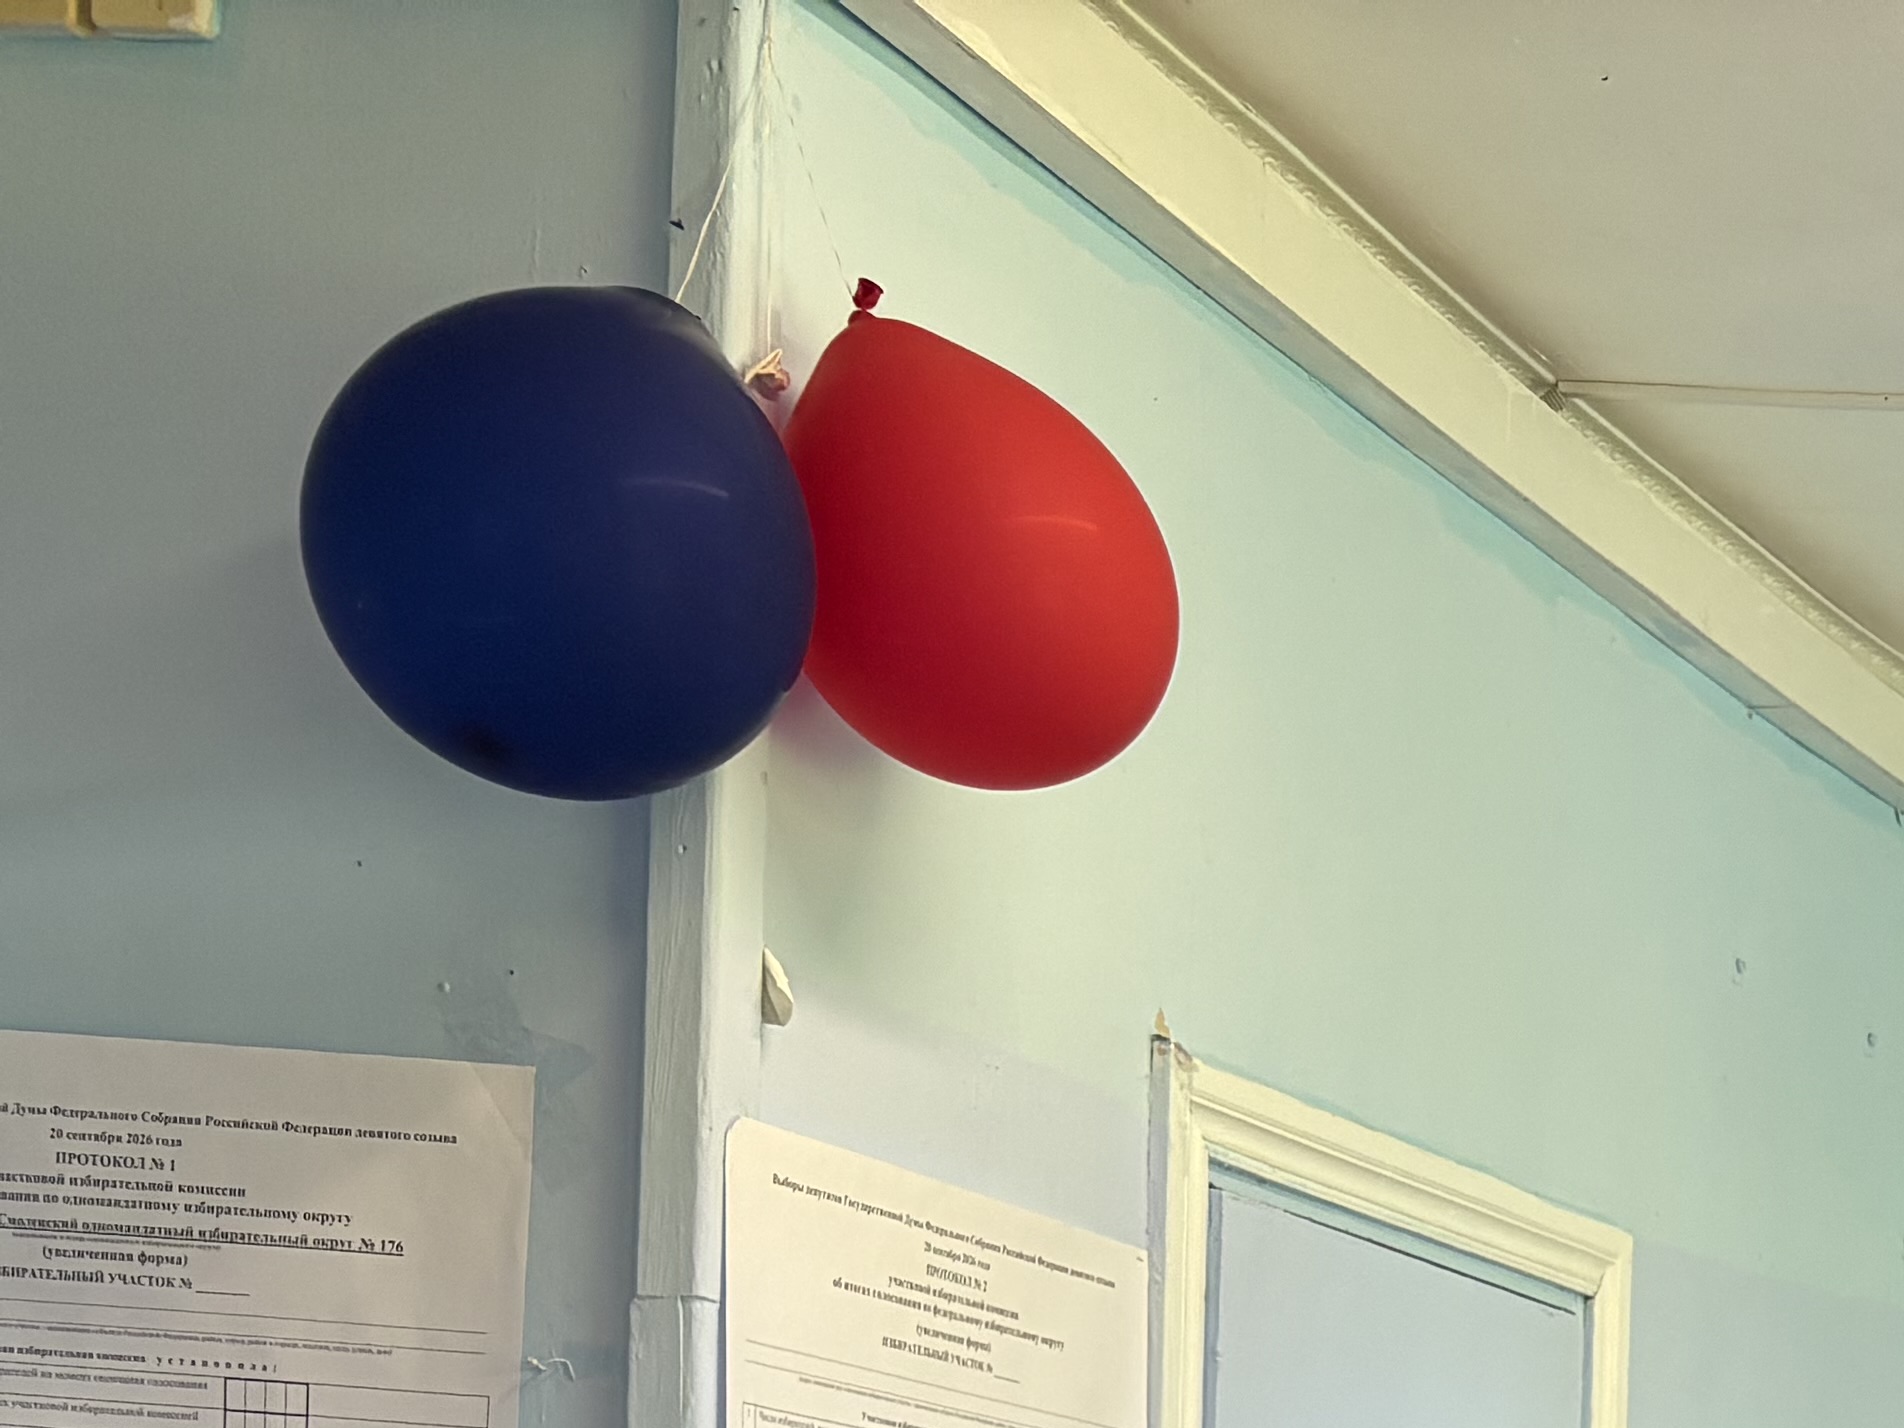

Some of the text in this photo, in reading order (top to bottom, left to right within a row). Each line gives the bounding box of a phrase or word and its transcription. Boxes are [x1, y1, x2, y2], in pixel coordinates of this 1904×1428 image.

[10, 1102, 47, 1116] Думы
[49, 1105, 137, 1121] Федерального
[141, 1111, 201, 1126] Собрания
[205, 1115, 279, 1131] Российской
[282, 1121, 352, 1137] Федерации
[50, 1128, 63, 1139] 20
[66, 1130, 123, 1143] сентября
[126, 1133, 153, 1145] 2026
[55, 1152, 145, 1170] ПРОТОКОЛ
[149, 1157, 164, 1171] №
[177, 1183, 246, 1198] комиссии
[303, 1210, 353, 1227] округу
[380, 1239, 404, 1253] 176
[138, 1252, 188, 1268] форма)
[108, 1273, 176, 1288] УЧАСТОК
